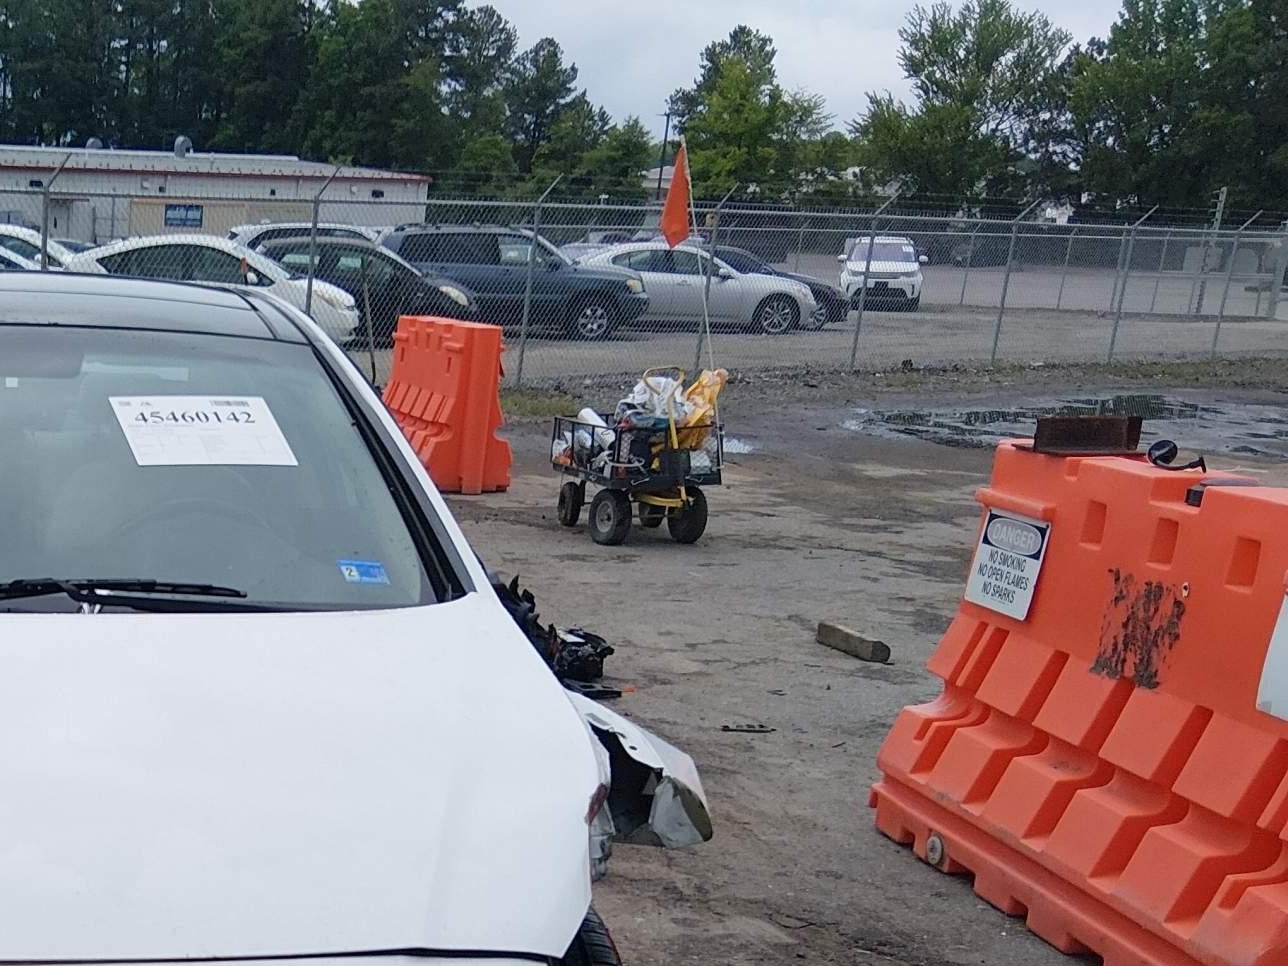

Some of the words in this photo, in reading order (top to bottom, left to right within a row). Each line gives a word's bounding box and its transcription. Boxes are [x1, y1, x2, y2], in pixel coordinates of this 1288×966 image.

[134, 411, 256, 424] 45460142
[993, 524, 1035, 549] DANGER
[989, 549, 998, 564] NO
[999, 552, 1027, 572] SMOKING
[977, 564, 987, 576] NO
[987, 566, 1004, 582] OPEN
[1004, 570, 1030, 590] FLAMES
[981, 581, 991, 595] NO
[992, 584, 1016, 603] SPARKS
